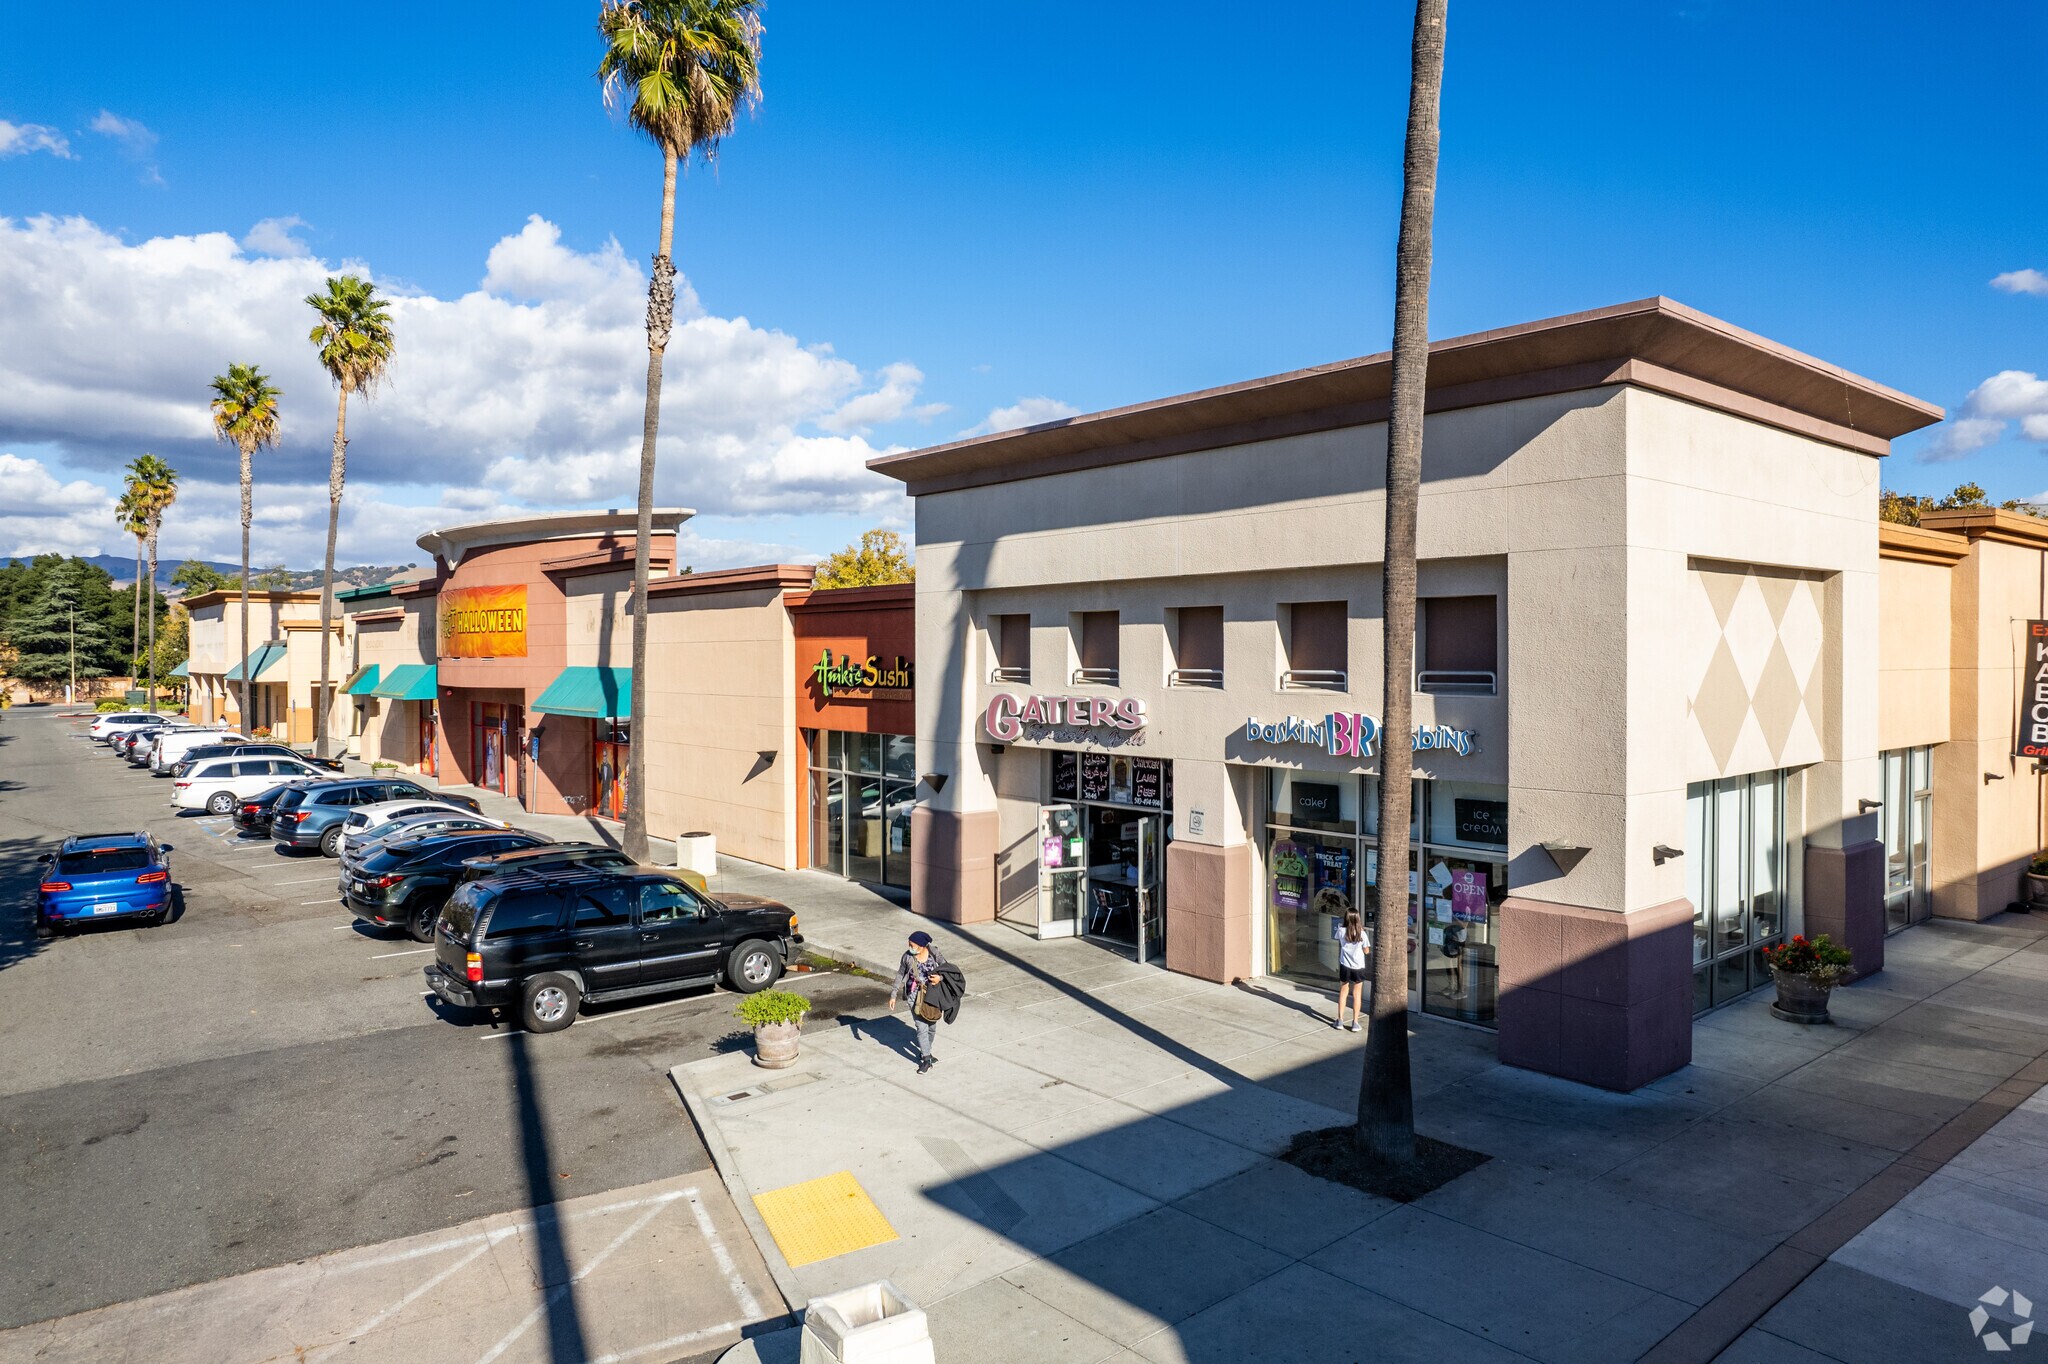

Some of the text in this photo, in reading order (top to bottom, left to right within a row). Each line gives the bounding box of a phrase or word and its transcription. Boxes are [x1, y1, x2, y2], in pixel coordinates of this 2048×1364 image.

[458, 609, 523, 634] HALLOWEEN
[863, 655, 909, 686] Sushi
[986, 693, 1148, 740] GATERS
[1107, 728, 1147, 751] Grill
[1247, 715, 1324, 747] baskin
[1325, 712, 1379, 757] BR
[1133, 757, 1160, 769] CHICKEN
[1136, 770, 1157, 783] LAMB
[1137, 785, 1156, 797] BEEF
[1299, 797, 1327, 809] cakes
[1473, 808, 1490, 821] ice
[1462, 822, 1502, 836] cream
[1315, 852, 1334, 861] TRICK
[1323, 860, 1342, 868] TREAT
[1279, 890, 1301, 898] UNICORN
[1454, 883, 1486, 896] OPEN
